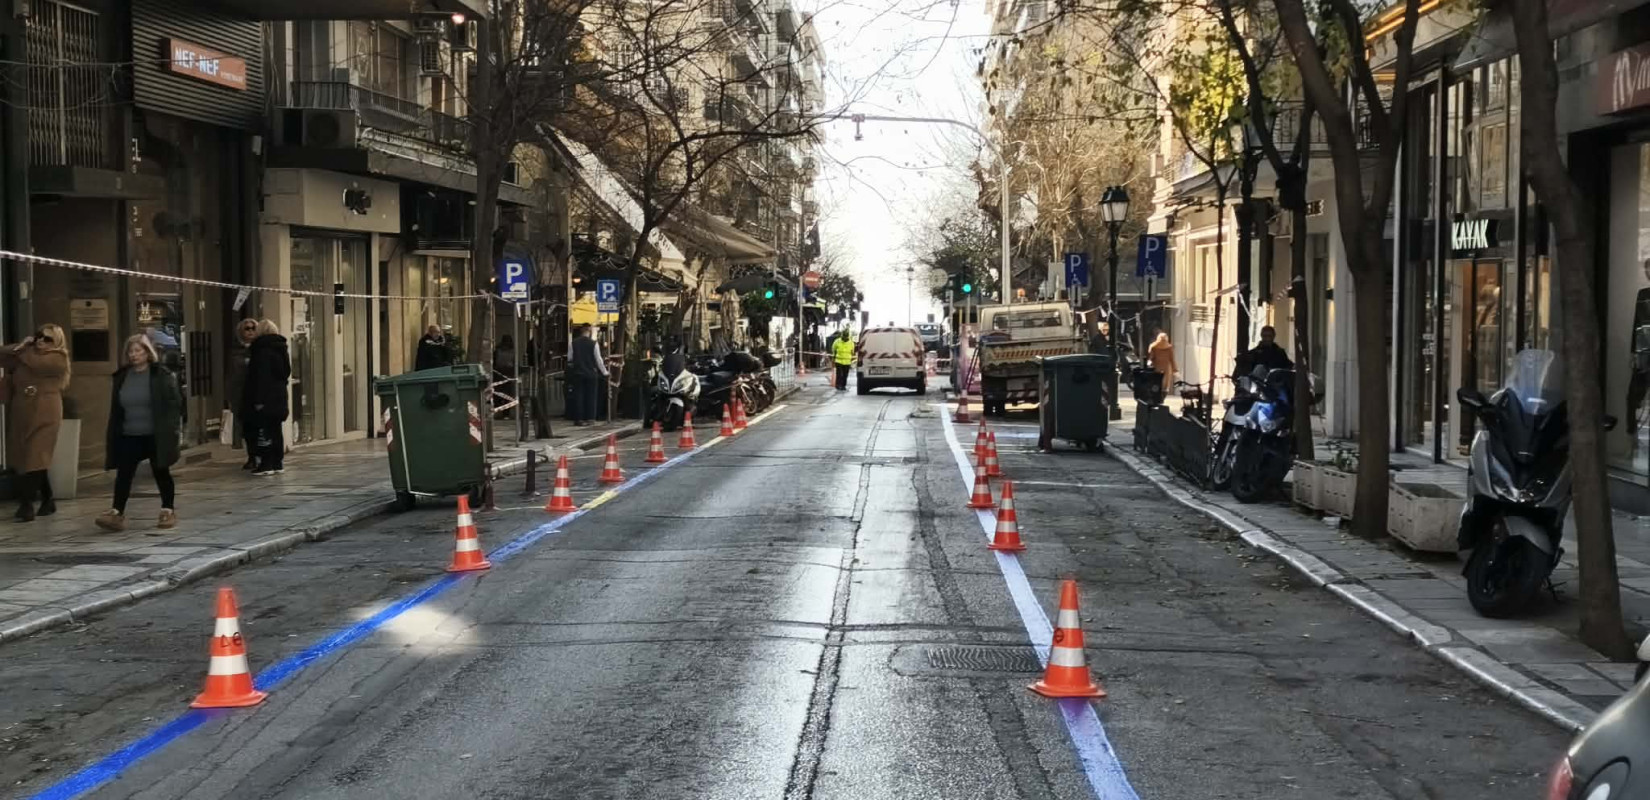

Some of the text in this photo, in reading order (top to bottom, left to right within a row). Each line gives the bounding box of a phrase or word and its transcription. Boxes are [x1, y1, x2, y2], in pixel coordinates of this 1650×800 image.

[174, 46, 219, 77] NEF-NEF
[1451, 218, 1489, 250] KAYAK
[1145, 236, 1160, 259] P
[506, 263, 523, 285] P
[1070, 254, 1081, 273] P
[602, 282, 615, 299] P
